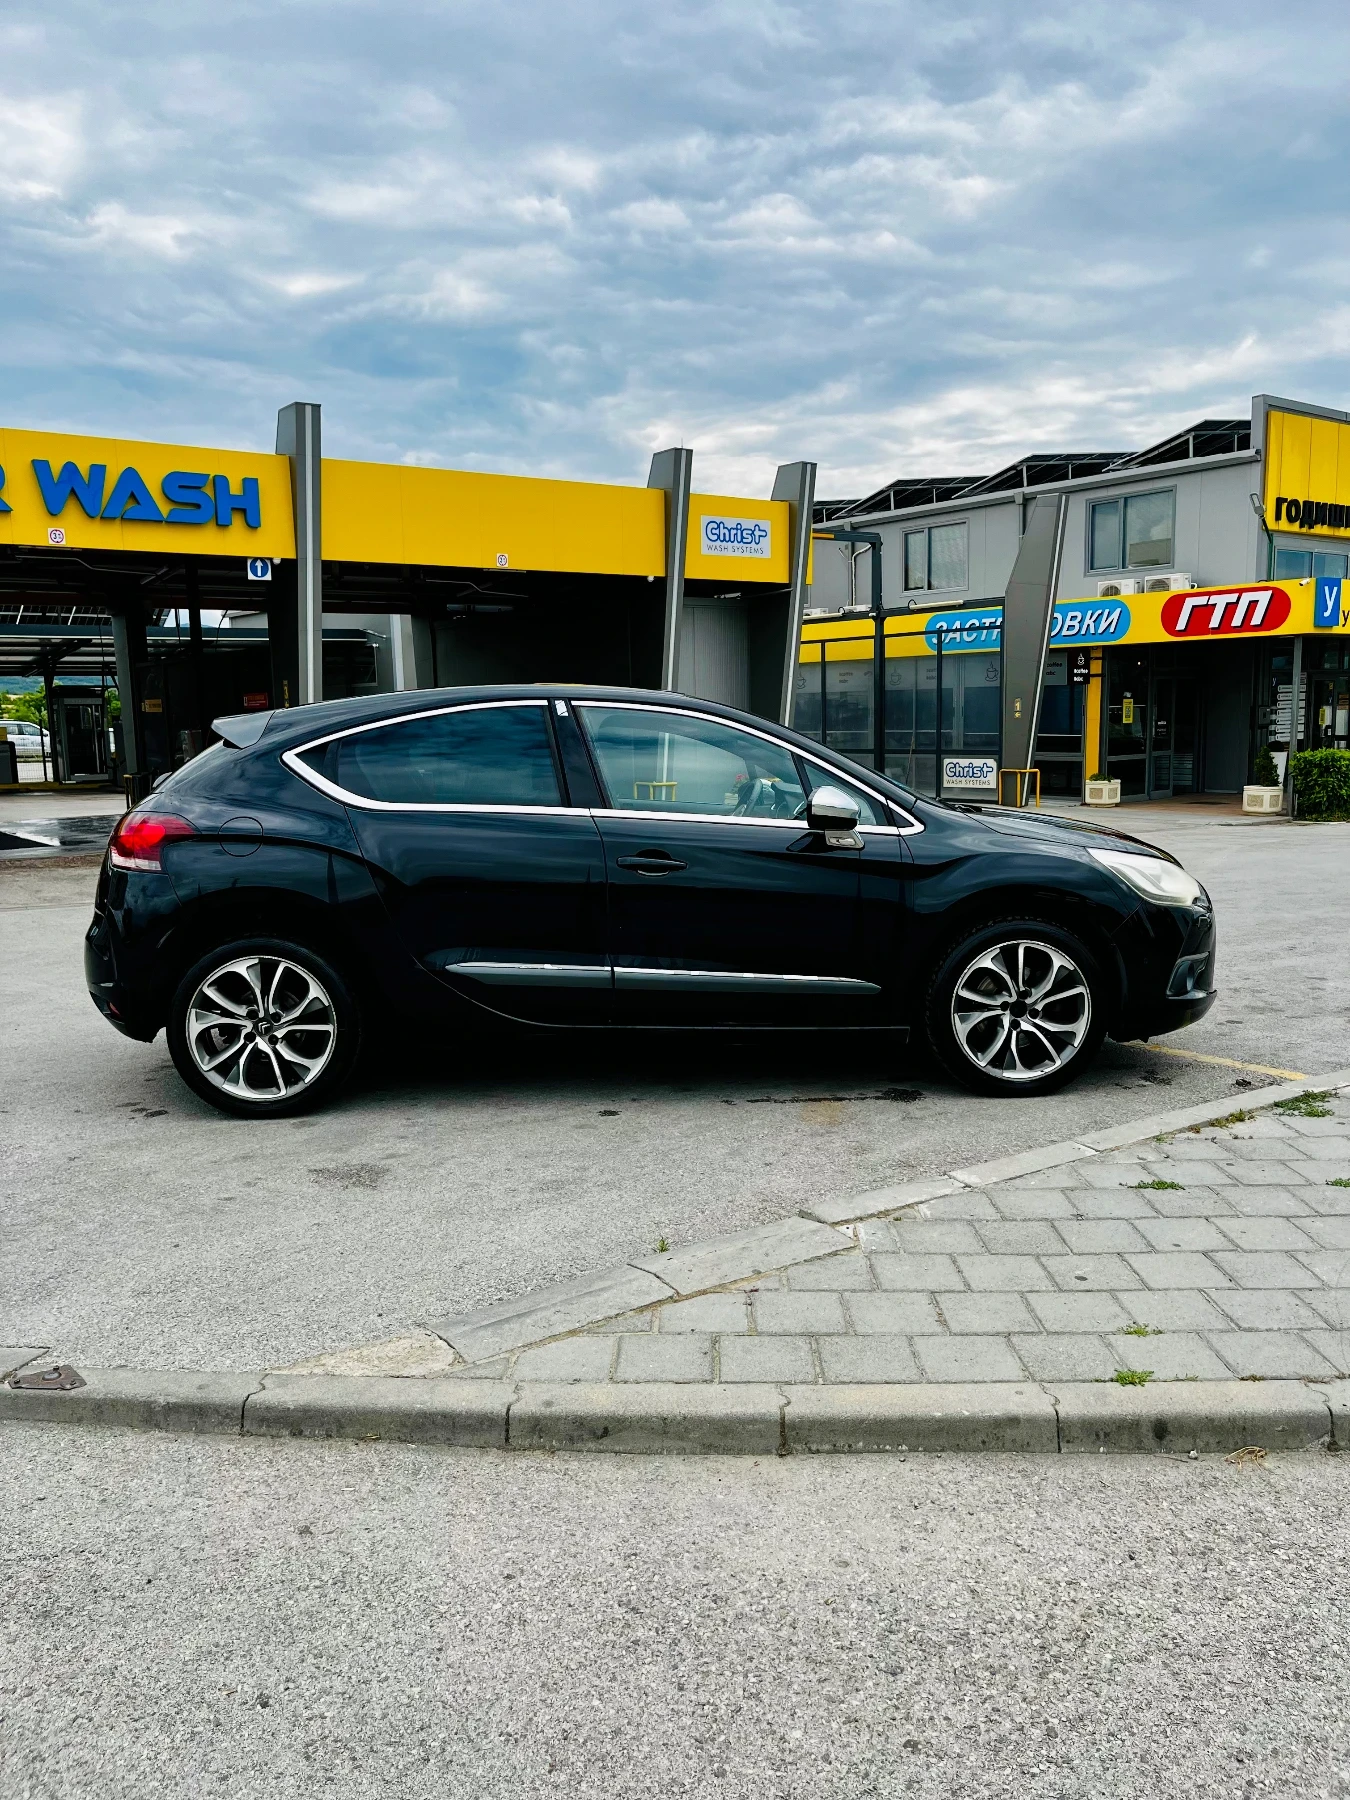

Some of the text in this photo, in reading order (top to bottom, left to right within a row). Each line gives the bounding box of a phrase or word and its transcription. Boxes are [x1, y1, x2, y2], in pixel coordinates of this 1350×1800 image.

[32, 459, 261, 529] WASH
[706, 521, 768, 545] Christ
[706, 544, 764, 555] WASH SYSTEMS
[1175, 590, 1274, 631] ГТП
[946, 762, 993, 779] Christ
